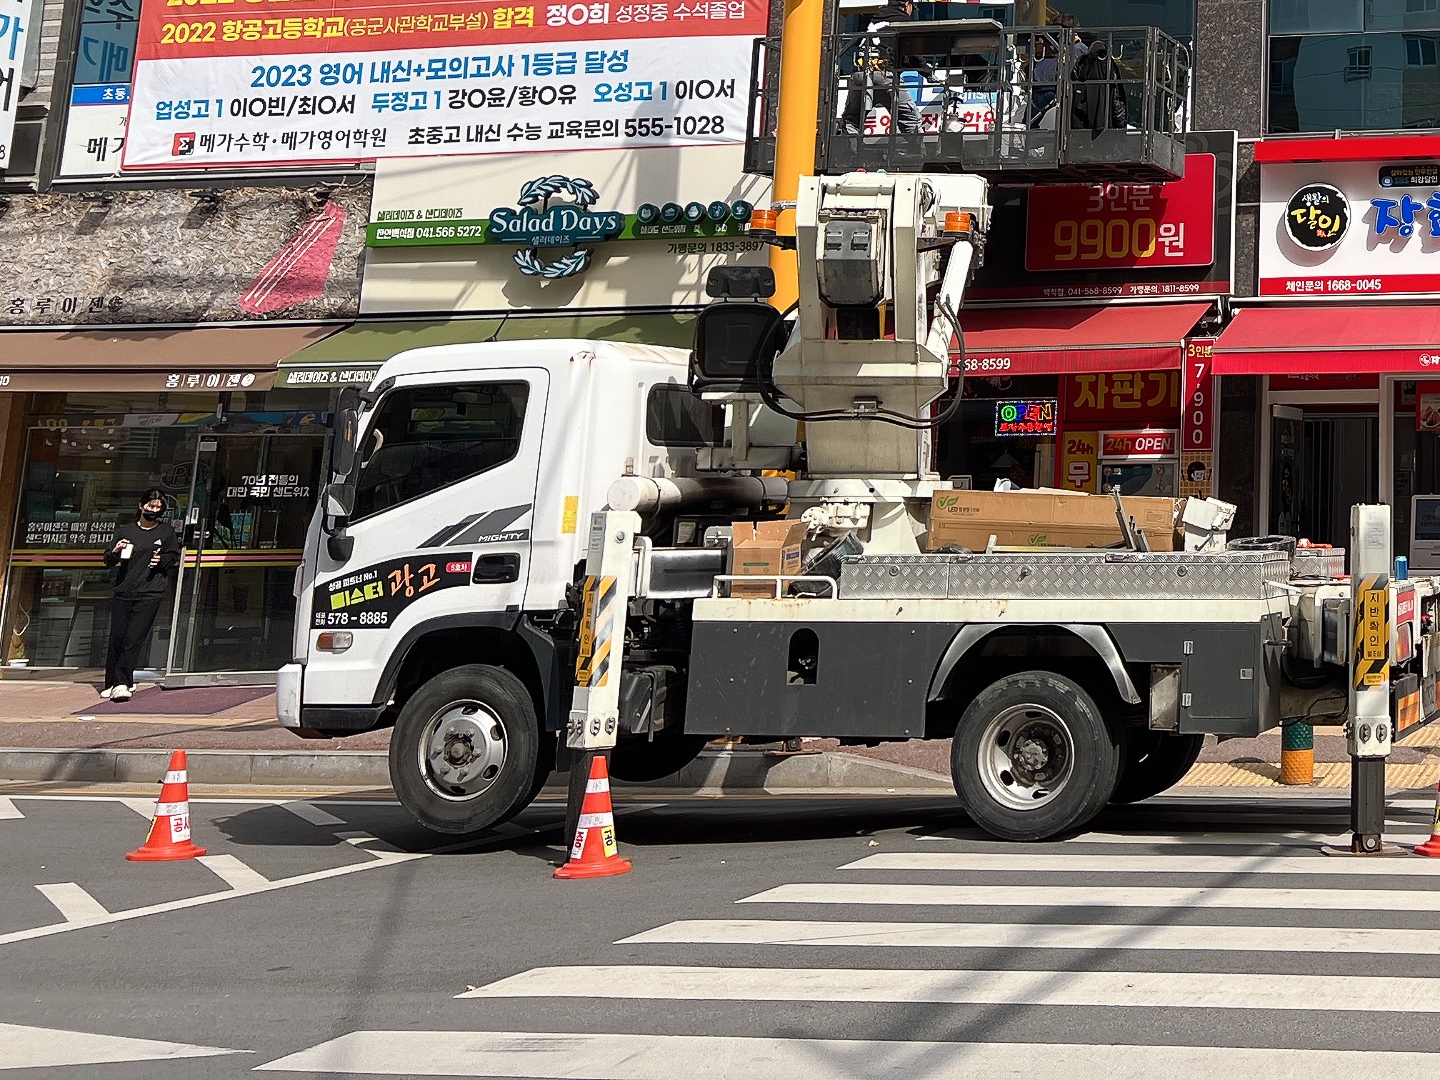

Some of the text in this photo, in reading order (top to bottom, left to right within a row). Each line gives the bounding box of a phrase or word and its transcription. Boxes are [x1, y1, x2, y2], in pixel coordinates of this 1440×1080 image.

[160, 20, 216, 44] 2022
[492, 5, 535, 30] 합격
[615, 3, 668, 23] 성정중
[672, 0, 746, 21] 수석졸업
[250, 49, 630, 88] 2023 영어 내신+모의고사 1등급 달성
[155, 98, 210, 121] 업성고
[215, 98, 224, 119] 1
[370, 90, 429, 114] 두정고
[434, 90, 442, 110] 1
[592, 80, 653, 103] 오성고
[659, 80, 668, 101] 1
[407, 126, 461, 146] 초중고
[466, 123, 501, 144] 내신
[506, 122, 543, 142] 수능
[547, 118, 620, 140] 교육문의
[623, 115, 725, 140] 555-1028
[456, 225, 482, 237] 5272
[490, 209, 617, 236] Salad Days
[1291, 205, 1341, 237] 달인
[667, 241, 765, 254] 가맹문의 1833-3897
[1054, 218, 1186, 261] 9900원
[1161, 284, 1200, 293] 1811-8599
[1326, 278, 1382, 291] 1668-0045
[1073, 371, 1179, 409] 자판기
[1001, 404, 1053, 422] OPEN
[1067, 438, 1094, 454] 24h
[1105, 436, 1171, 452] 24h OPEN
[249, 486, 271, 498] 국민
[478, 532, 525, 543] MIGHTY
[387, 563, 441, 599] 광고
